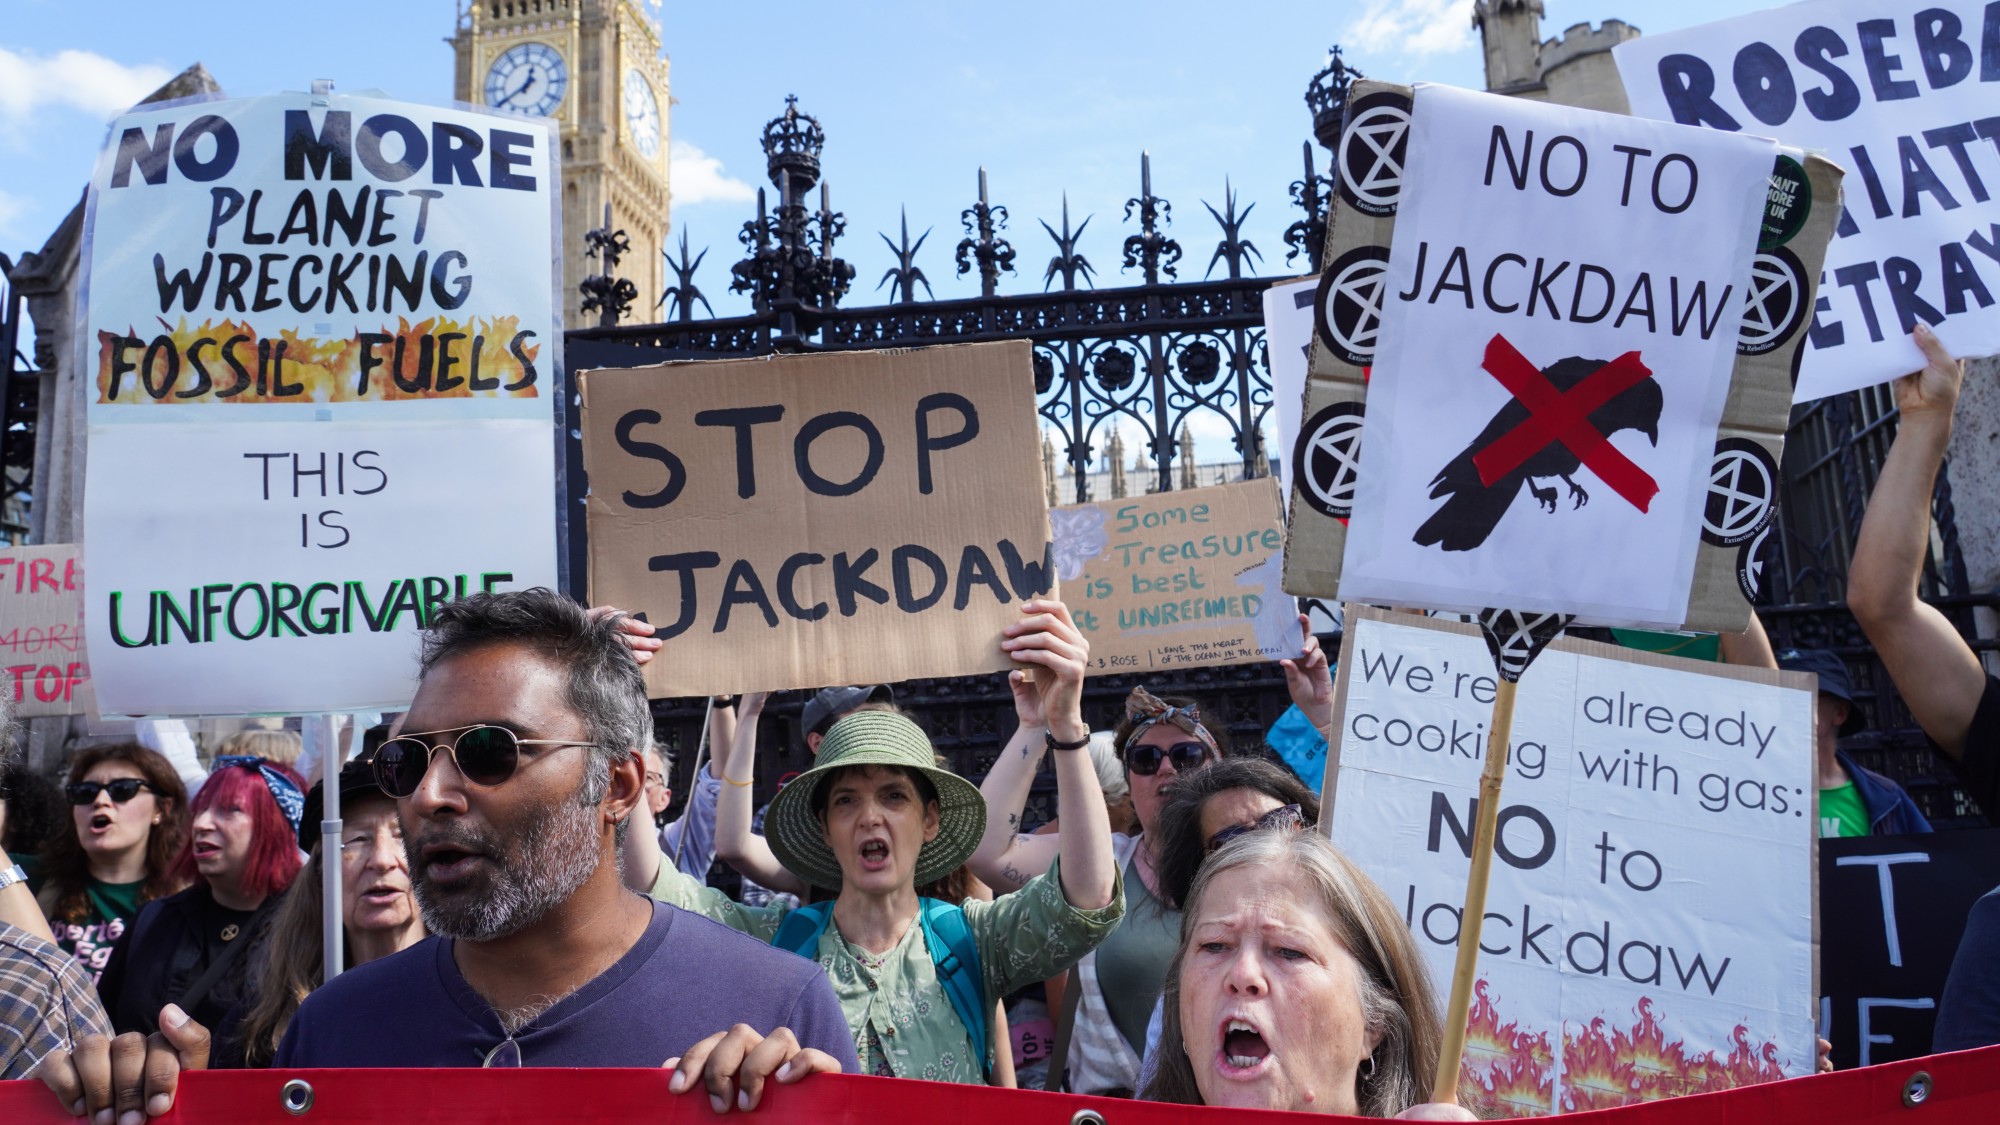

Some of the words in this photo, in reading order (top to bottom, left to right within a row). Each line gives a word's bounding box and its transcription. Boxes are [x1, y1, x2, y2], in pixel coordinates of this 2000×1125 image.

[110, 114, 240, 189] NO
[283, 109, 537, 192] MORE
[1483, 125, 1589, 198] NO
[1613, 144, 1699, 214] TO
[207, 185, 444, 249] PLANET
[1770, 203, 1788, 220] UK
[153, 249, 473, 314] WRECKING
[1399, 242, 1733, 340] JACKDAW
[108, 333, 304, 402] FOSSIL
[357, 330, 539, 398] FUELS
[243, 450, 388, 500] THIS
[614, 392, 980, 509] STOP
[301, 510, 350, 548] IS
[1114, 527, 1281, 568] Treasure
[1115, 503, 1211, 533] Some
[632, 539, 1054, 641] JACKDAW
[1084, 573, 1114, 599] is
[1132, 566, 1206, 594] best
[1119, 593, 1264, 630] UNREFINED
[1110, 655, 1139, 667] ROSE
[1157, 644, 1186, 655] LEAVE
[1190, 643, 1209, 651] THE
[1213, 638, 1245, 648] HEART
[1161, 654, 1171, 664] OF
[1174, 653, 1192, 662] THE
[1195, 651, 1222, 660] OCEAN
[1225, 649, 1235, 658] IN
[1238, 648, 1252, 657] THE
[1255, 646, 1283, 656] OCEAN
[1361, 648, 1497, 704] We're
[1583, 690, 1776, 759] already
[1578, 748, 1680, 796] with
[1698, 771, 1804, 818] gas:
[1427, 791, 1557, 870] NO
[1594, 830, 1662, 892] to
